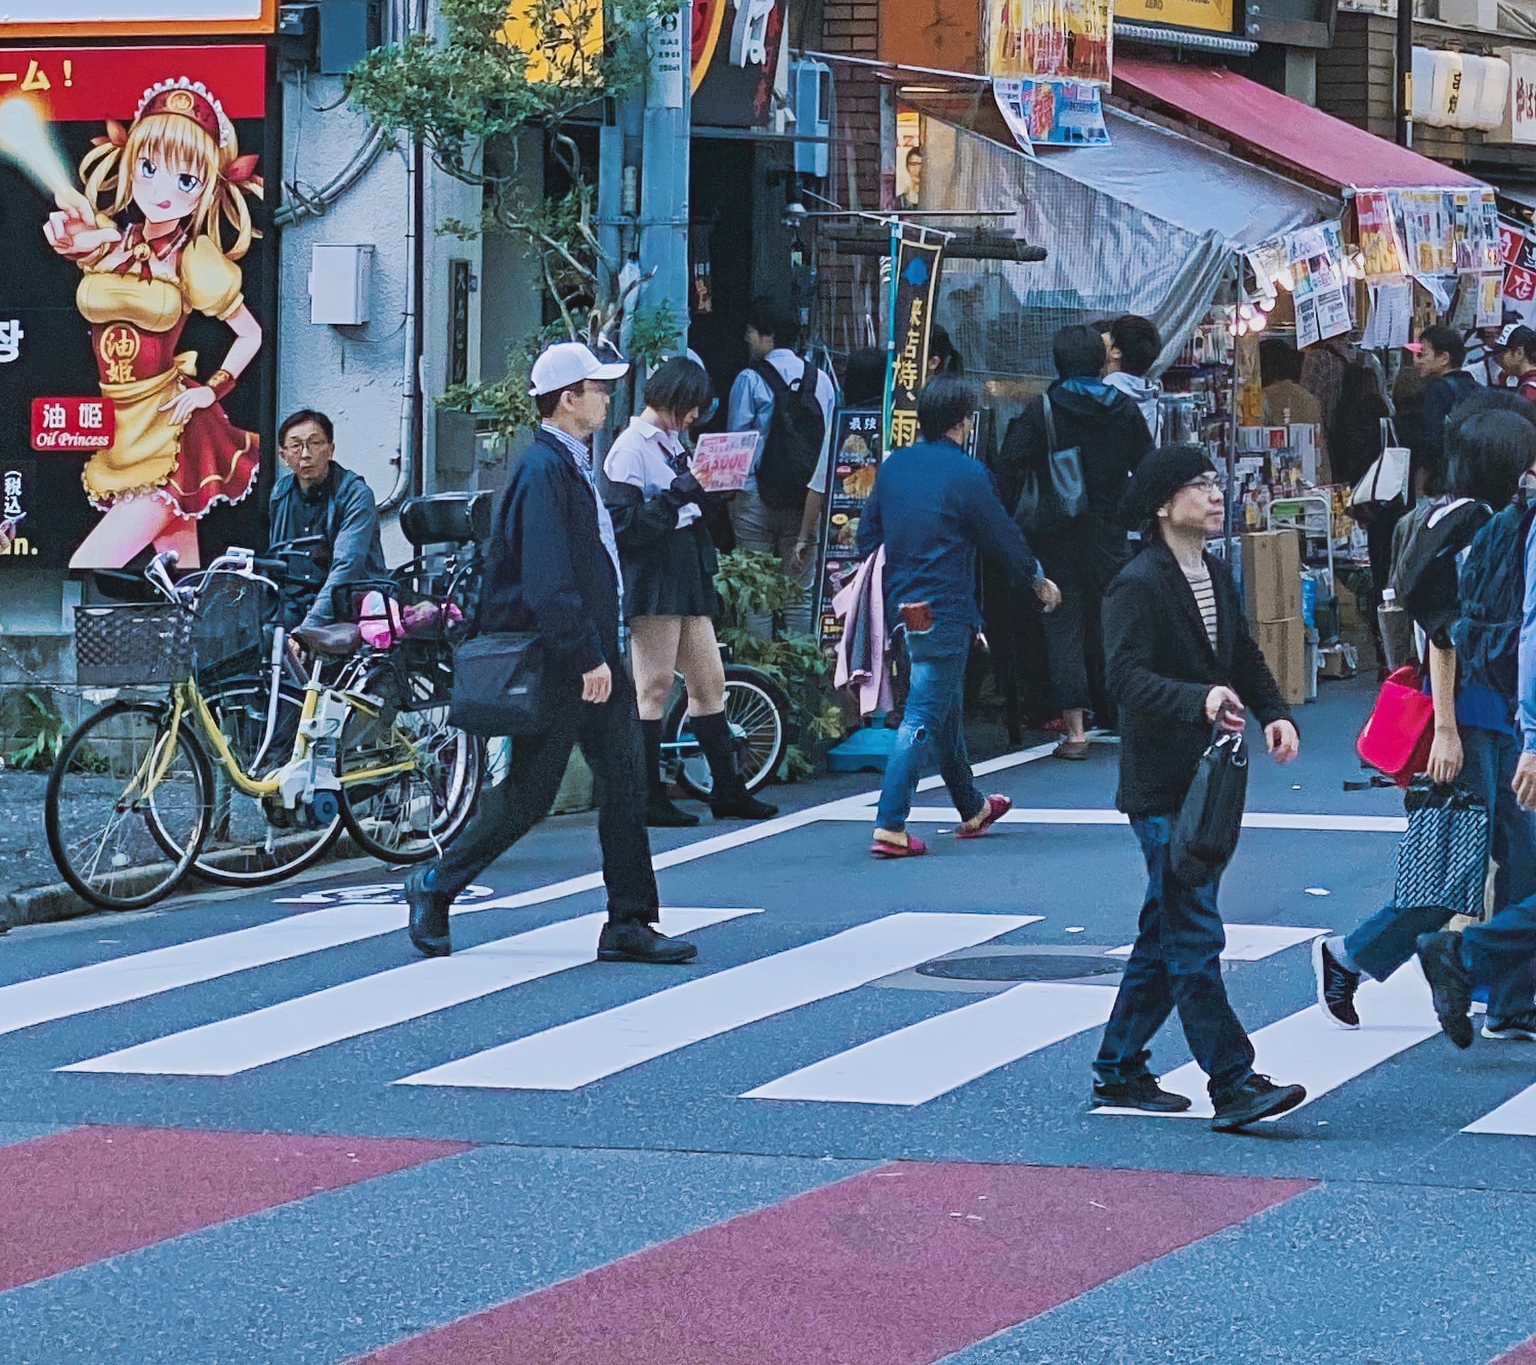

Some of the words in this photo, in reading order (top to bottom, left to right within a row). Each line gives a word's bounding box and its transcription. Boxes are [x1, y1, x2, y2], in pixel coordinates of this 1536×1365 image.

[43, 401, 104, 430] 油姫
[849, 416, 877, 431] 最強
[36, 432, 58, 448] Oil
[61, 432, 110, 448] Princess
